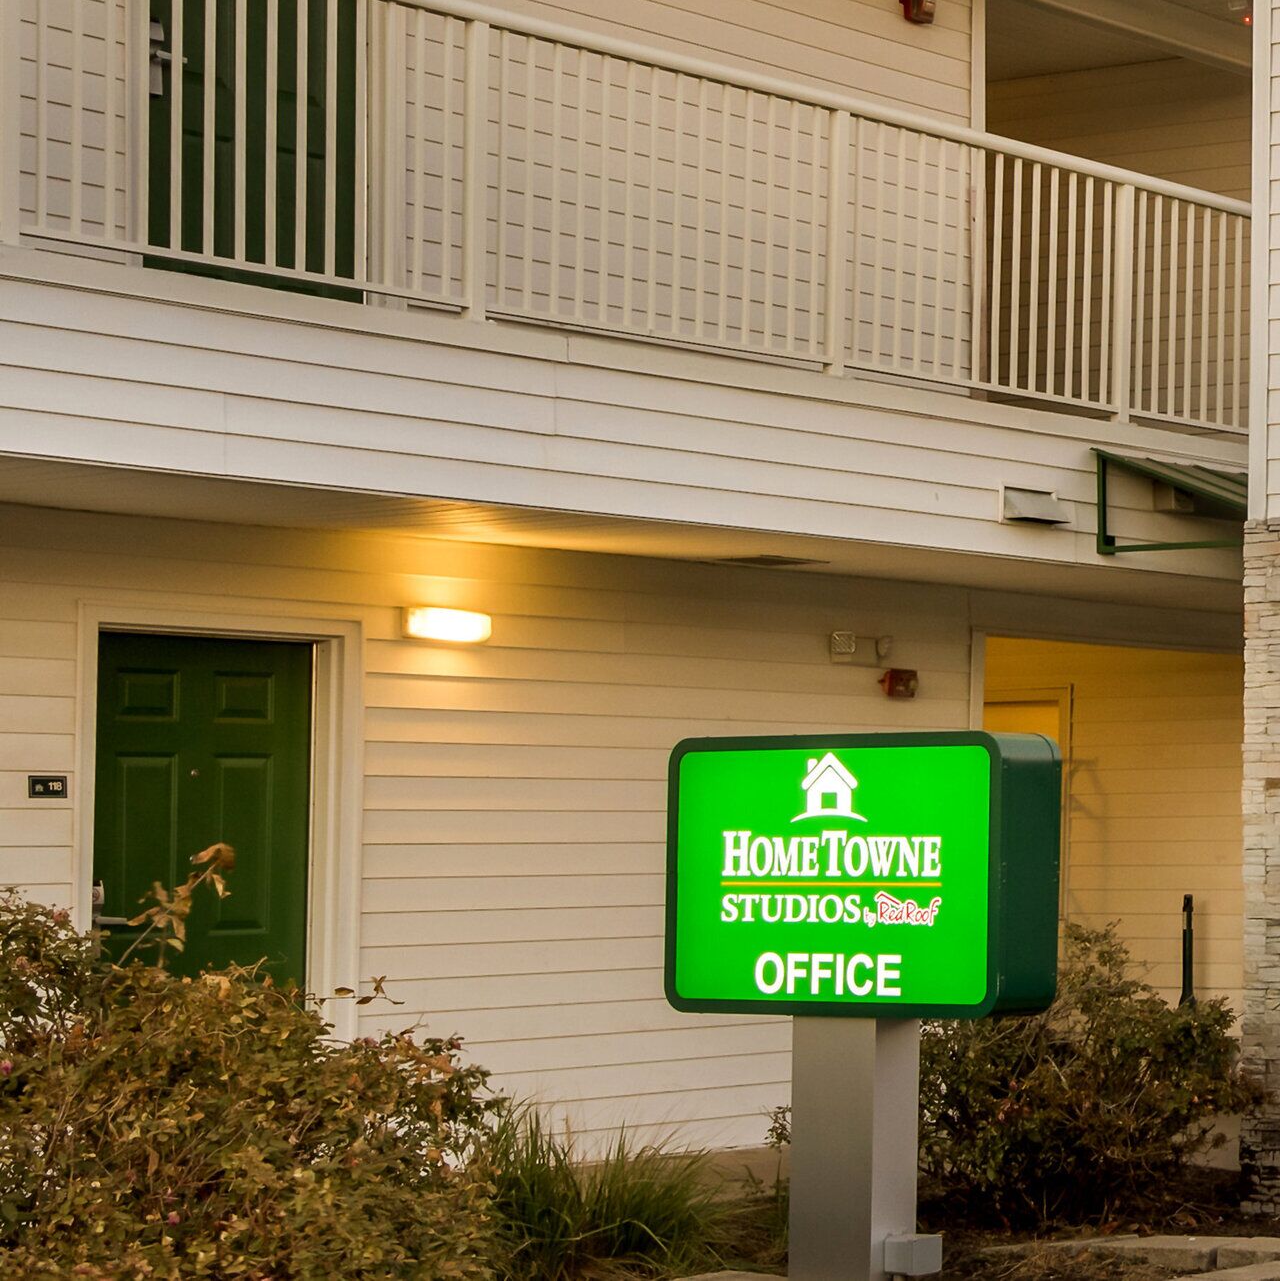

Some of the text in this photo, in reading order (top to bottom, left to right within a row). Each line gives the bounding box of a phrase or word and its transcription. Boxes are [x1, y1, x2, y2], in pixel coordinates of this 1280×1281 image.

[721, 893, 861, 923] STUDIOS
[863, 907, 876, 927] by
[755, 952, 902, 996] OFFICE
